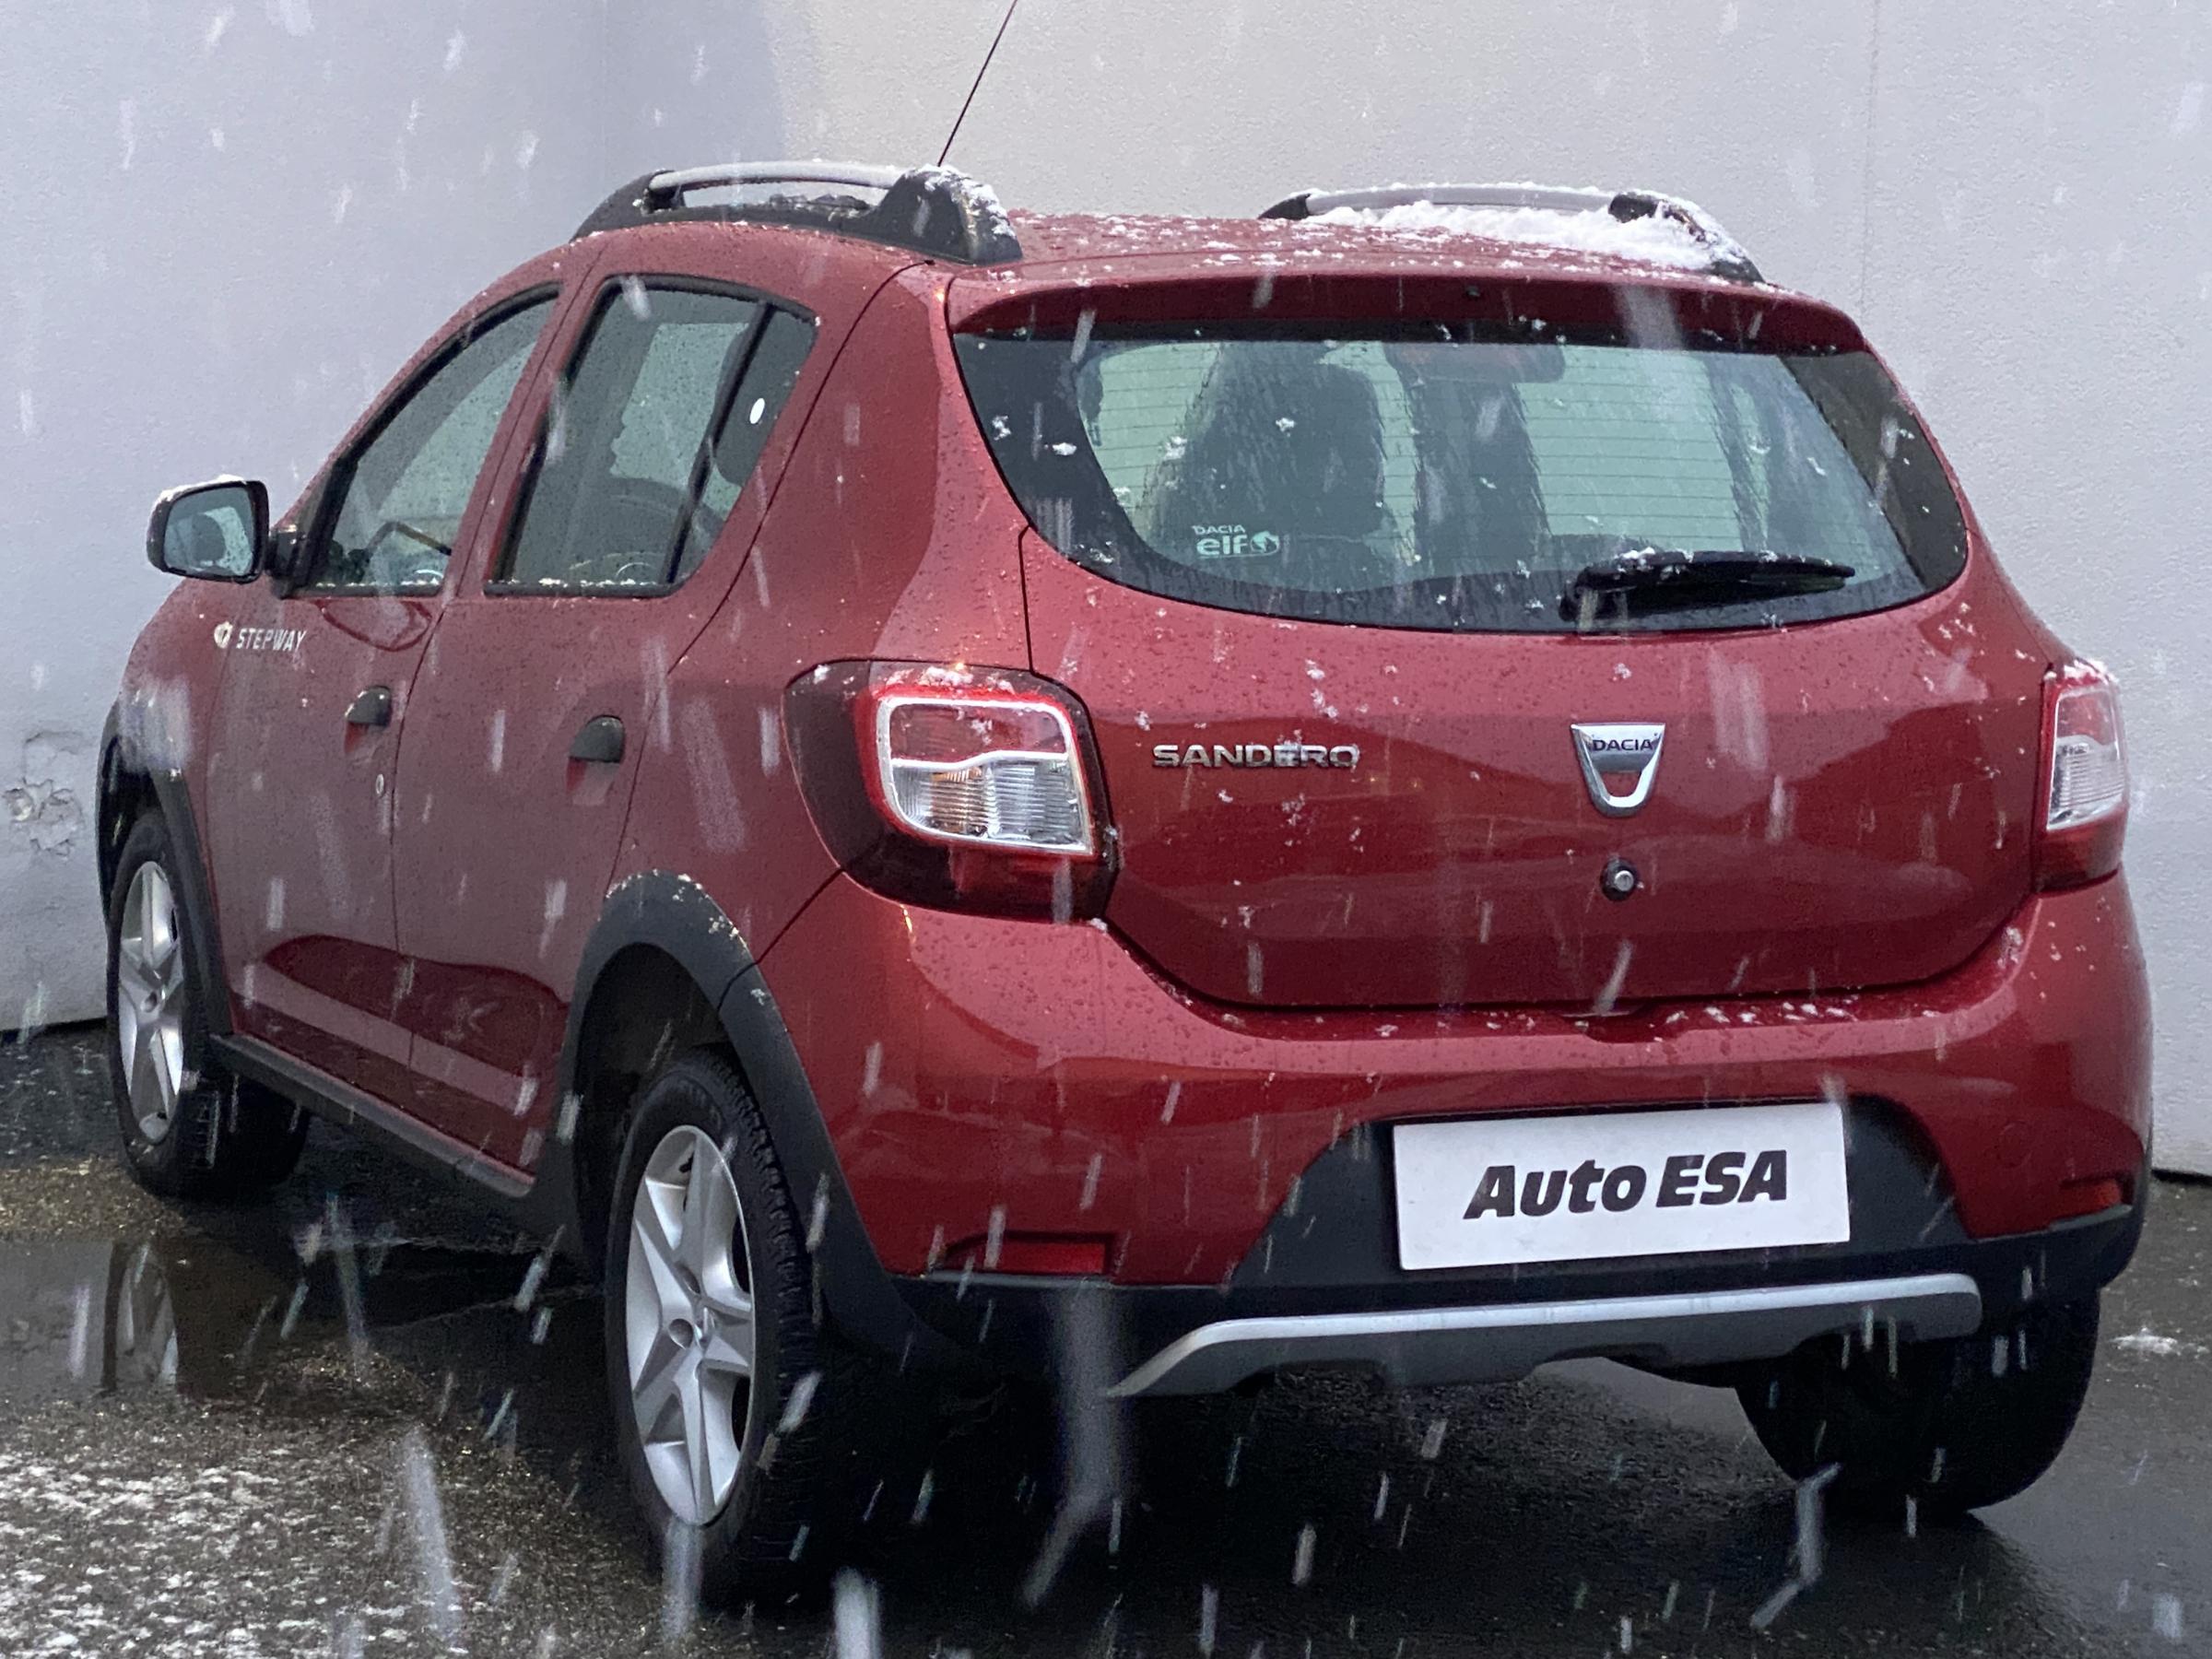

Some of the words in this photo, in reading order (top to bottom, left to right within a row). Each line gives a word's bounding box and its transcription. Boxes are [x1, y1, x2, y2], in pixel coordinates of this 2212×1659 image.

[1192, 524, 1246, 535] DACIA
[1196, 535, 1248, 556] elf
[236, 628, 307, 652] STEPWAY
[1152, 744, 1361, 768] SANDERO
[1592, 739, 1653, 751] DACIA
[1463, 1159, 1647, 1220] Auto
[1655, 1149, 1787, 1208] ESA
